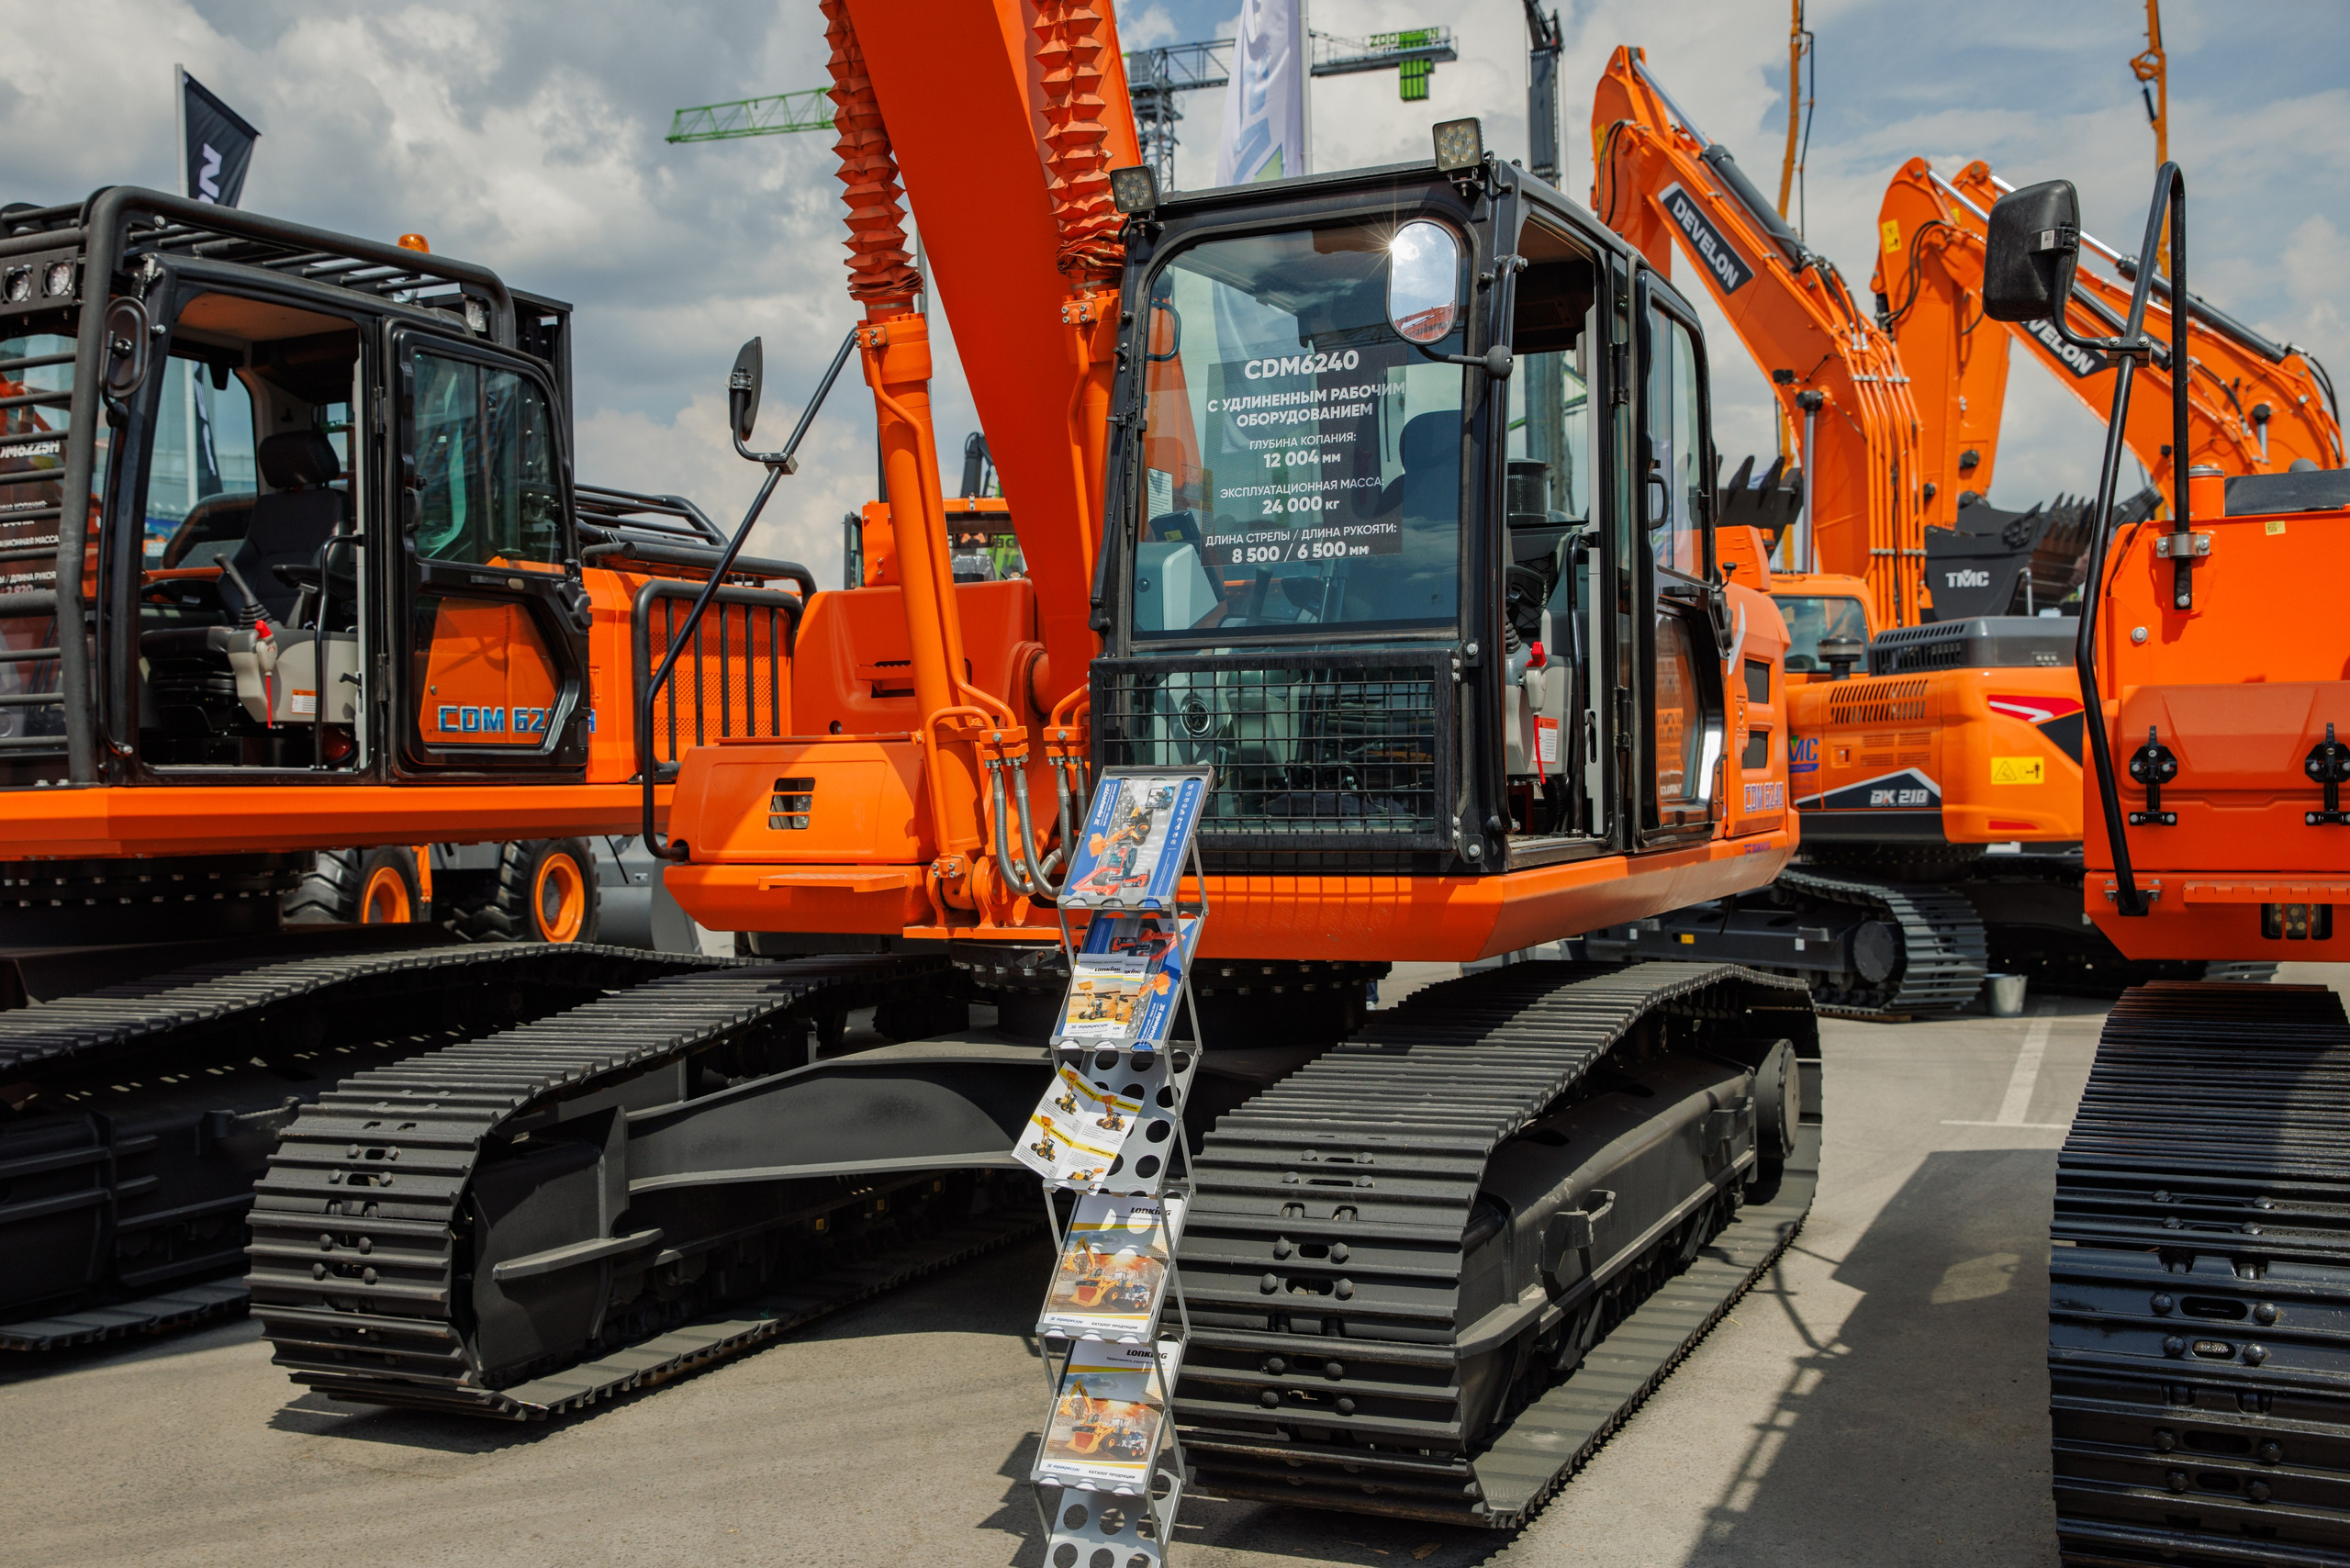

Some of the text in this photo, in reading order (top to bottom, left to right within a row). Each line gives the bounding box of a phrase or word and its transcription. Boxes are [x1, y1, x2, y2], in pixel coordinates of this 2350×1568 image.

[1672, 196, 1740, 289] DEVELON
[2022, 319, 2096, 375] VELON
[1244, 350, 1360, 379] CDM6240
[1207, 382, 1405, 412] С УДЛИНЕННЫМ РАБОЧИМ
[1236, 402, 1373, 428] ОБОРУДОВАНИЕМ
[1249, 432, 1357, 451] ГЛУБИНА КОПАНИЯ:
[1263, 449, 1341, 468] 12 004 мм
[1220, 476, 1385, 498] ЭКСПЛУАТАЦИОННАЯ МАССА:
[1262, 496, 1340, 515] 24 000 кг
[1205, 534, 1244, 548] ДЛИНА
[1246, 530, 1291, 544] СТРЕЛЫ
[1301, 527, 1341, 541] ДЛИНА
[1343, 522, 1397, 537] РУКОЯТИ:
[1231, 549, 1243, 564] 8
[1246, 545, 1280, 562] 500
[1297, 543, 1308, 559] 6
[1313, 541, 1347, 557] 500
[1349, 544, 1370, 555] мм
[1945, 570, 1989, 588] TMC
[438, 705, 505, 733] CDM
[1744, 783, 1763, 813] CDM
[1897, 790, 1930, 806] 210
